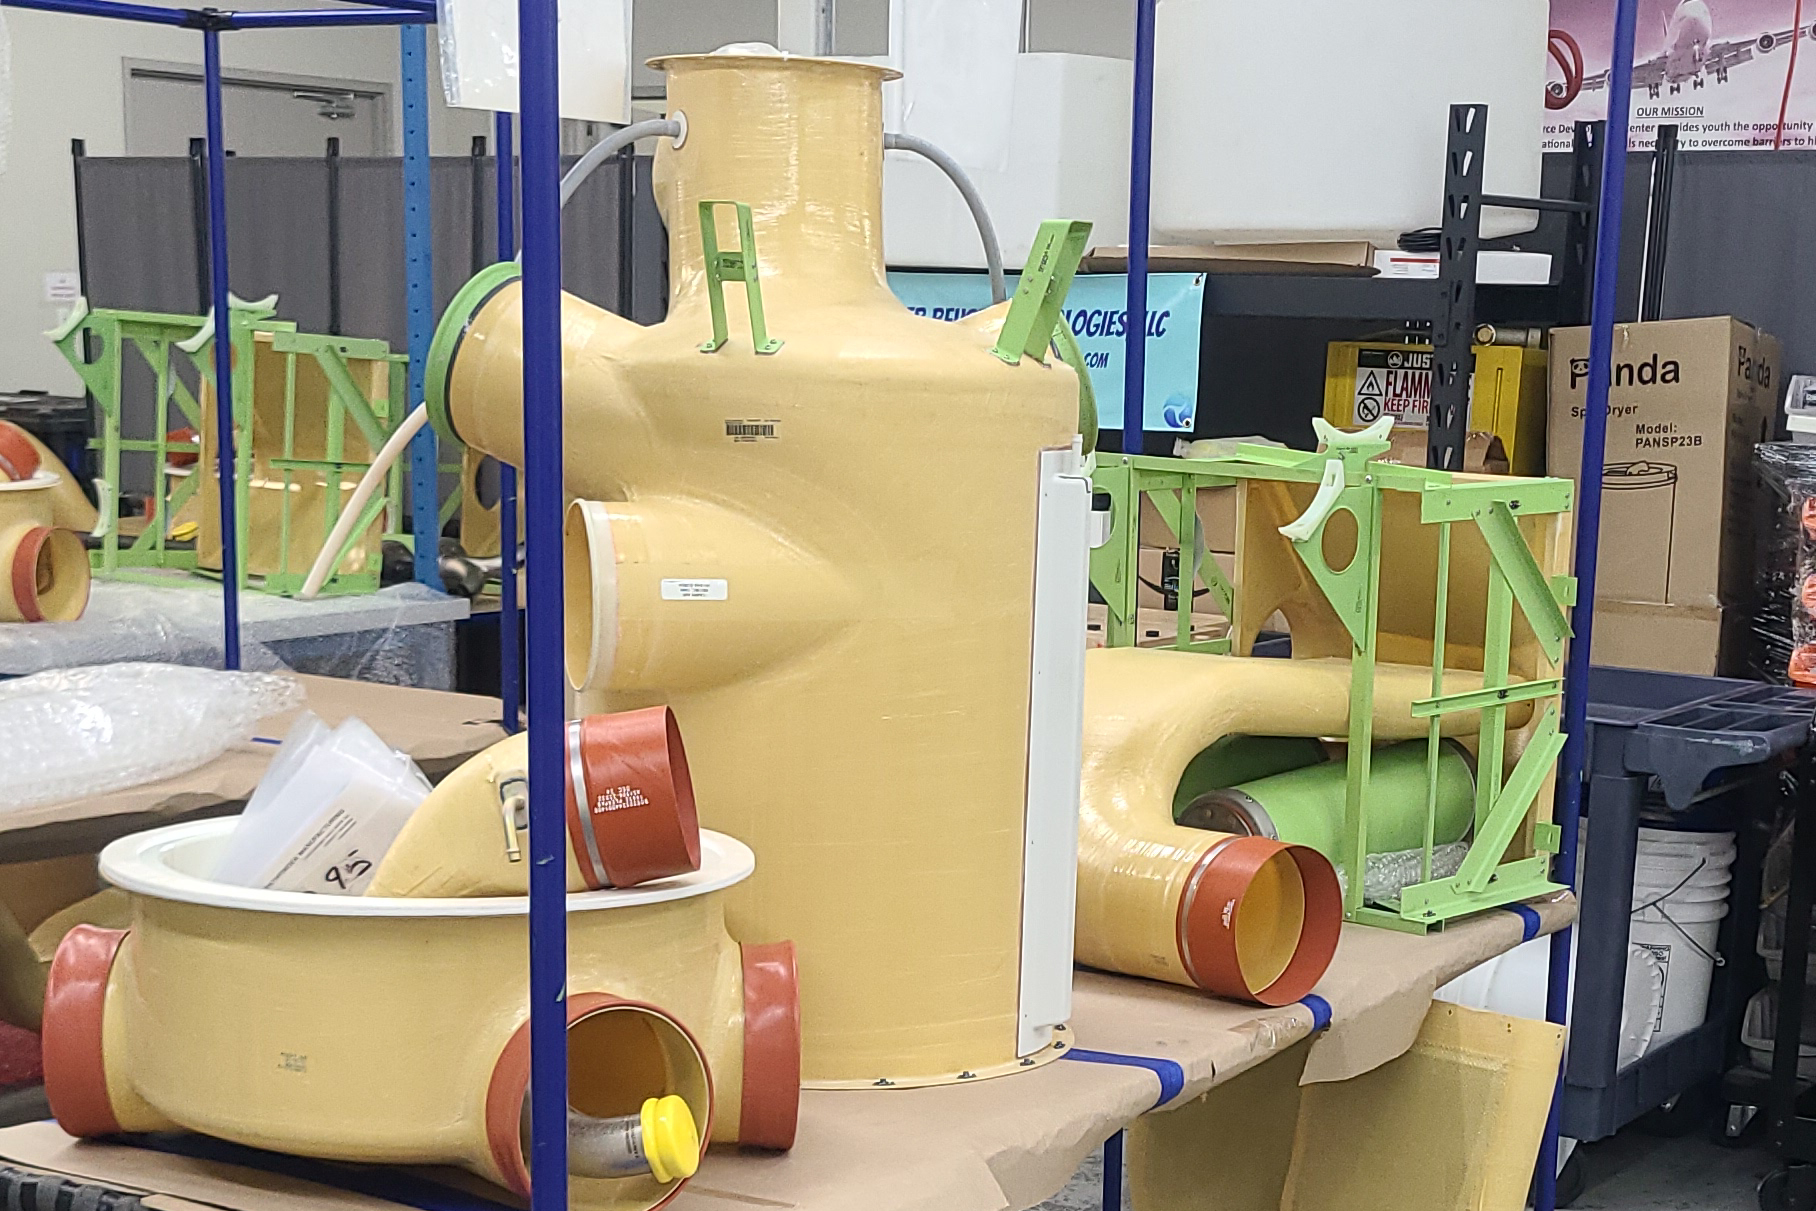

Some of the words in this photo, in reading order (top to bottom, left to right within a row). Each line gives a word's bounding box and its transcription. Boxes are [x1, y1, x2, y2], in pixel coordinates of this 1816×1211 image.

[1637, 107, 1658, 117] OUR
[1661, 106, 1704, 117] MISSION
[1628, 124, 1655, 133] enter
[1702, 121, 1730, 134] youth
[1733, 121, 1749, 131] the
[1752, 120, 1813, 133] oppotunity
[1689, 138, 1699, 147] to
[1701, 139, 1750, 147] overcome
[1794, 137, 1805, 146] to
[1146, 310, 1170, 337] LC
[1570, 353, 1680, 389] Pnda
[1738, 345, 1771, 389] Pada
[1384, 398, 1410, 413] KEEP
[1636, 423, 1677, 435] Model:
[1636, 436, 1702, 449] PANSP23B
